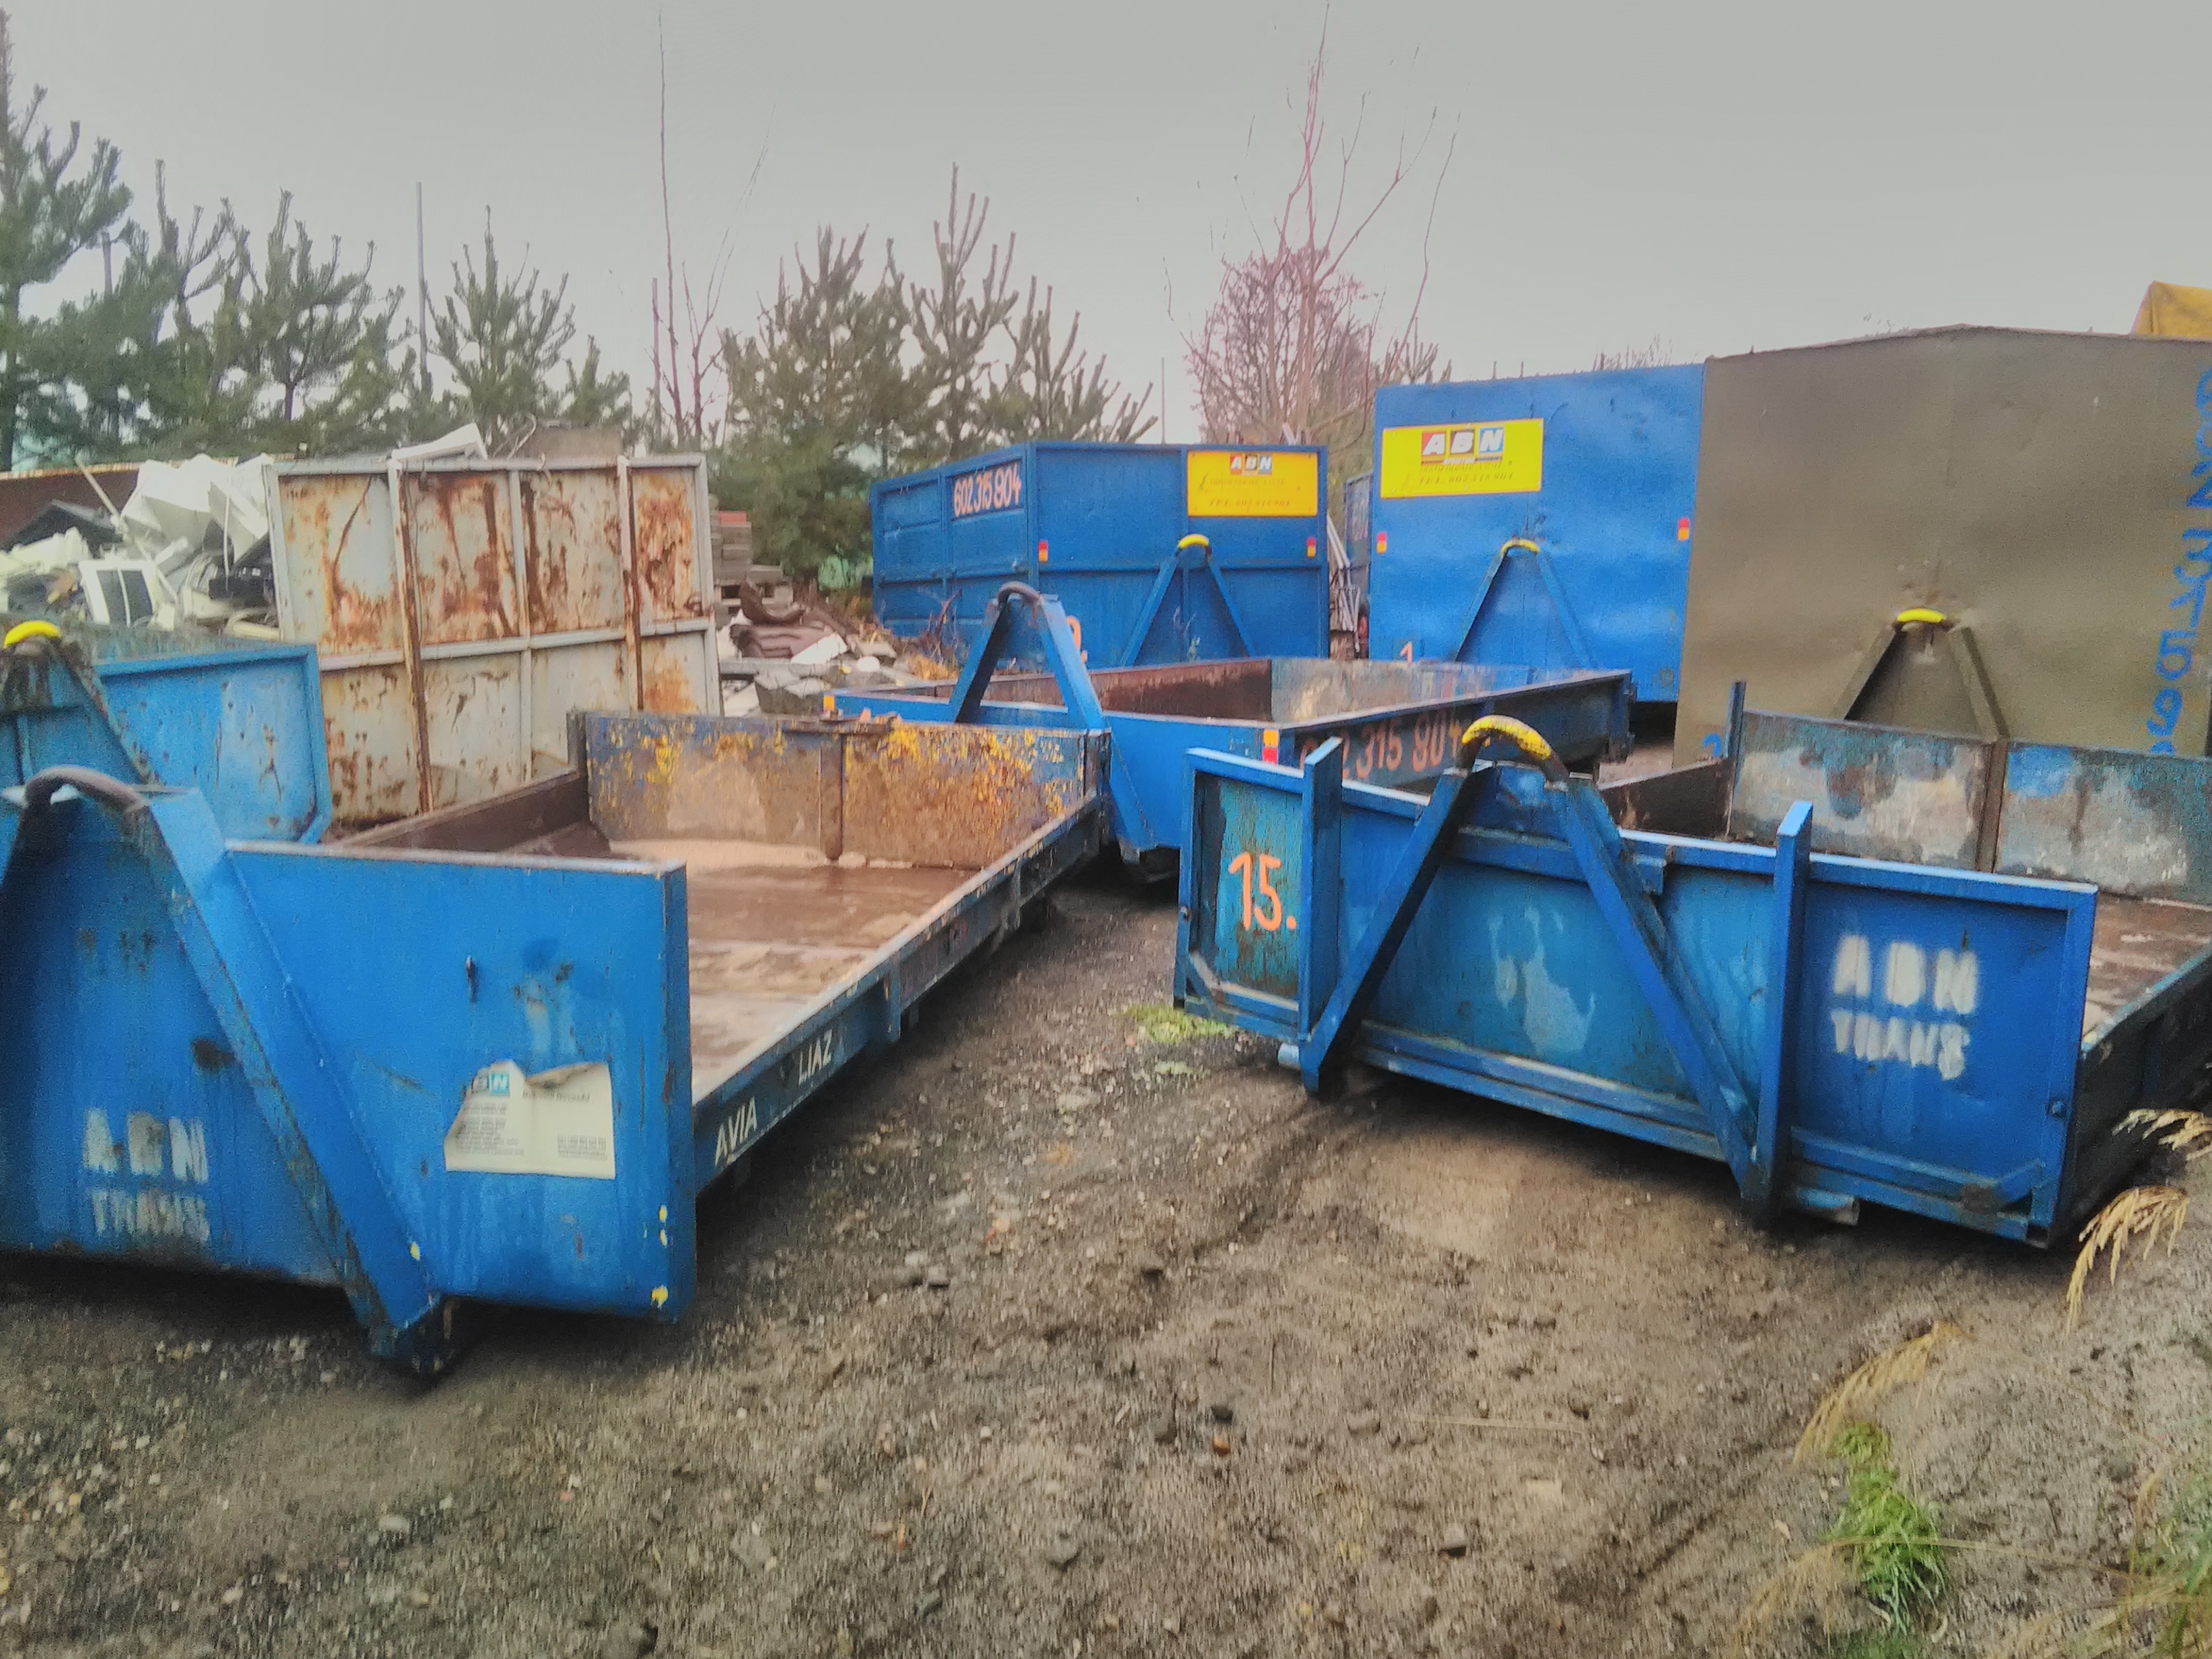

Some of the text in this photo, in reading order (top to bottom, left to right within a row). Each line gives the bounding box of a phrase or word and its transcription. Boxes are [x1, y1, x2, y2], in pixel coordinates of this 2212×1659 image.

[1230, 455, 1272, 471] ABN
[1422, 428, 1504, 457] ABN
[1228, 852, 1297, 932] 15.
[714, 1029, 832, 1167] AVIA LIAZ
